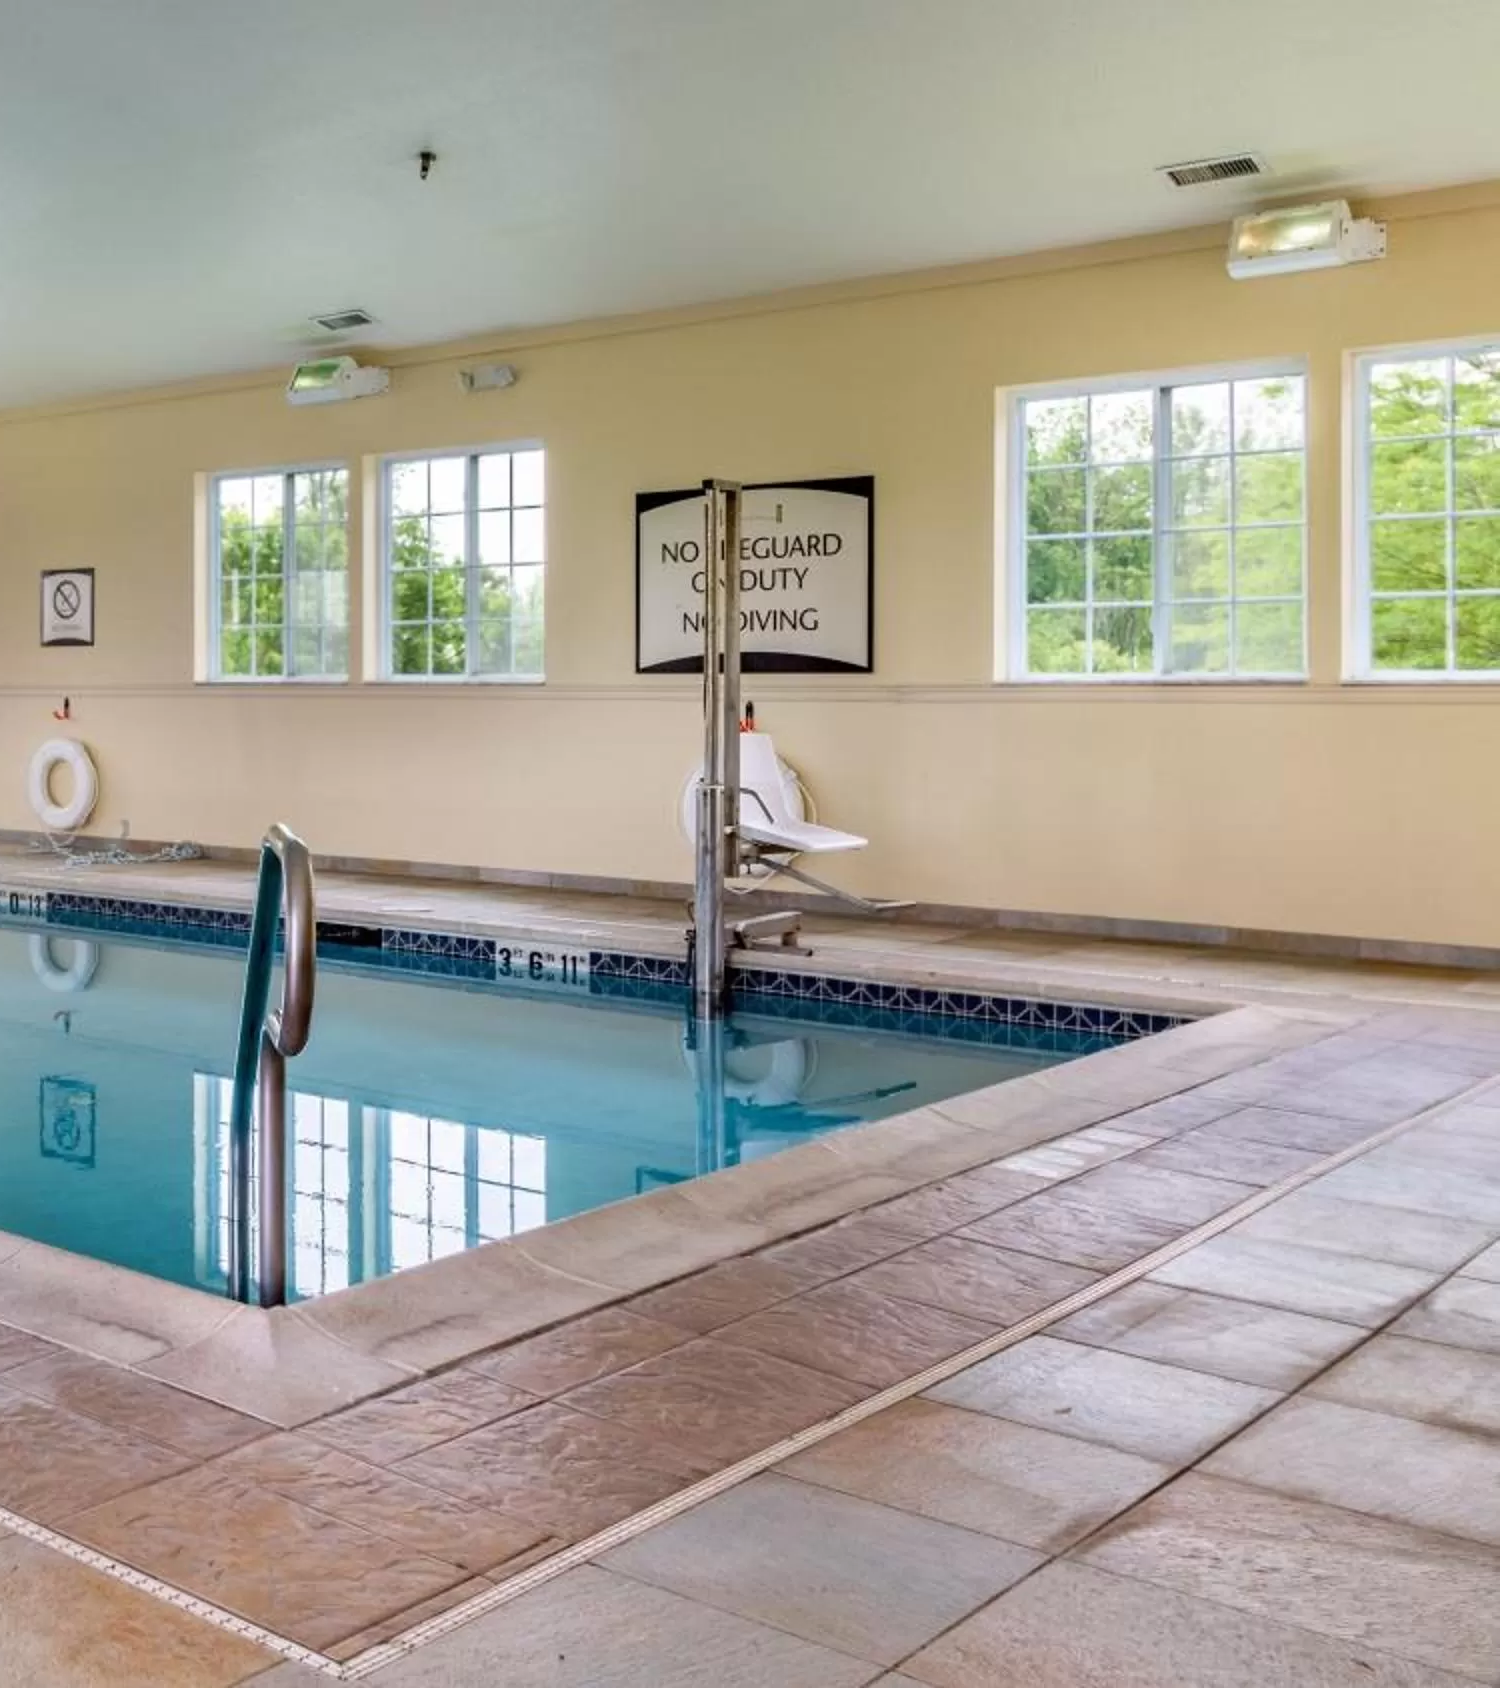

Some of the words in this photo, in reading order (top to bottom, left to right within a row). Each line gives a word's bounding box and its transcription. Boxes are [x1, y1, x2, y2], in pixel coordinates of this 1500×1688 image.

[661, 541, 699, 564] NO
[719, 533, 843, 562] IEGUARD
[739, 567, 809, 592] DUTY
